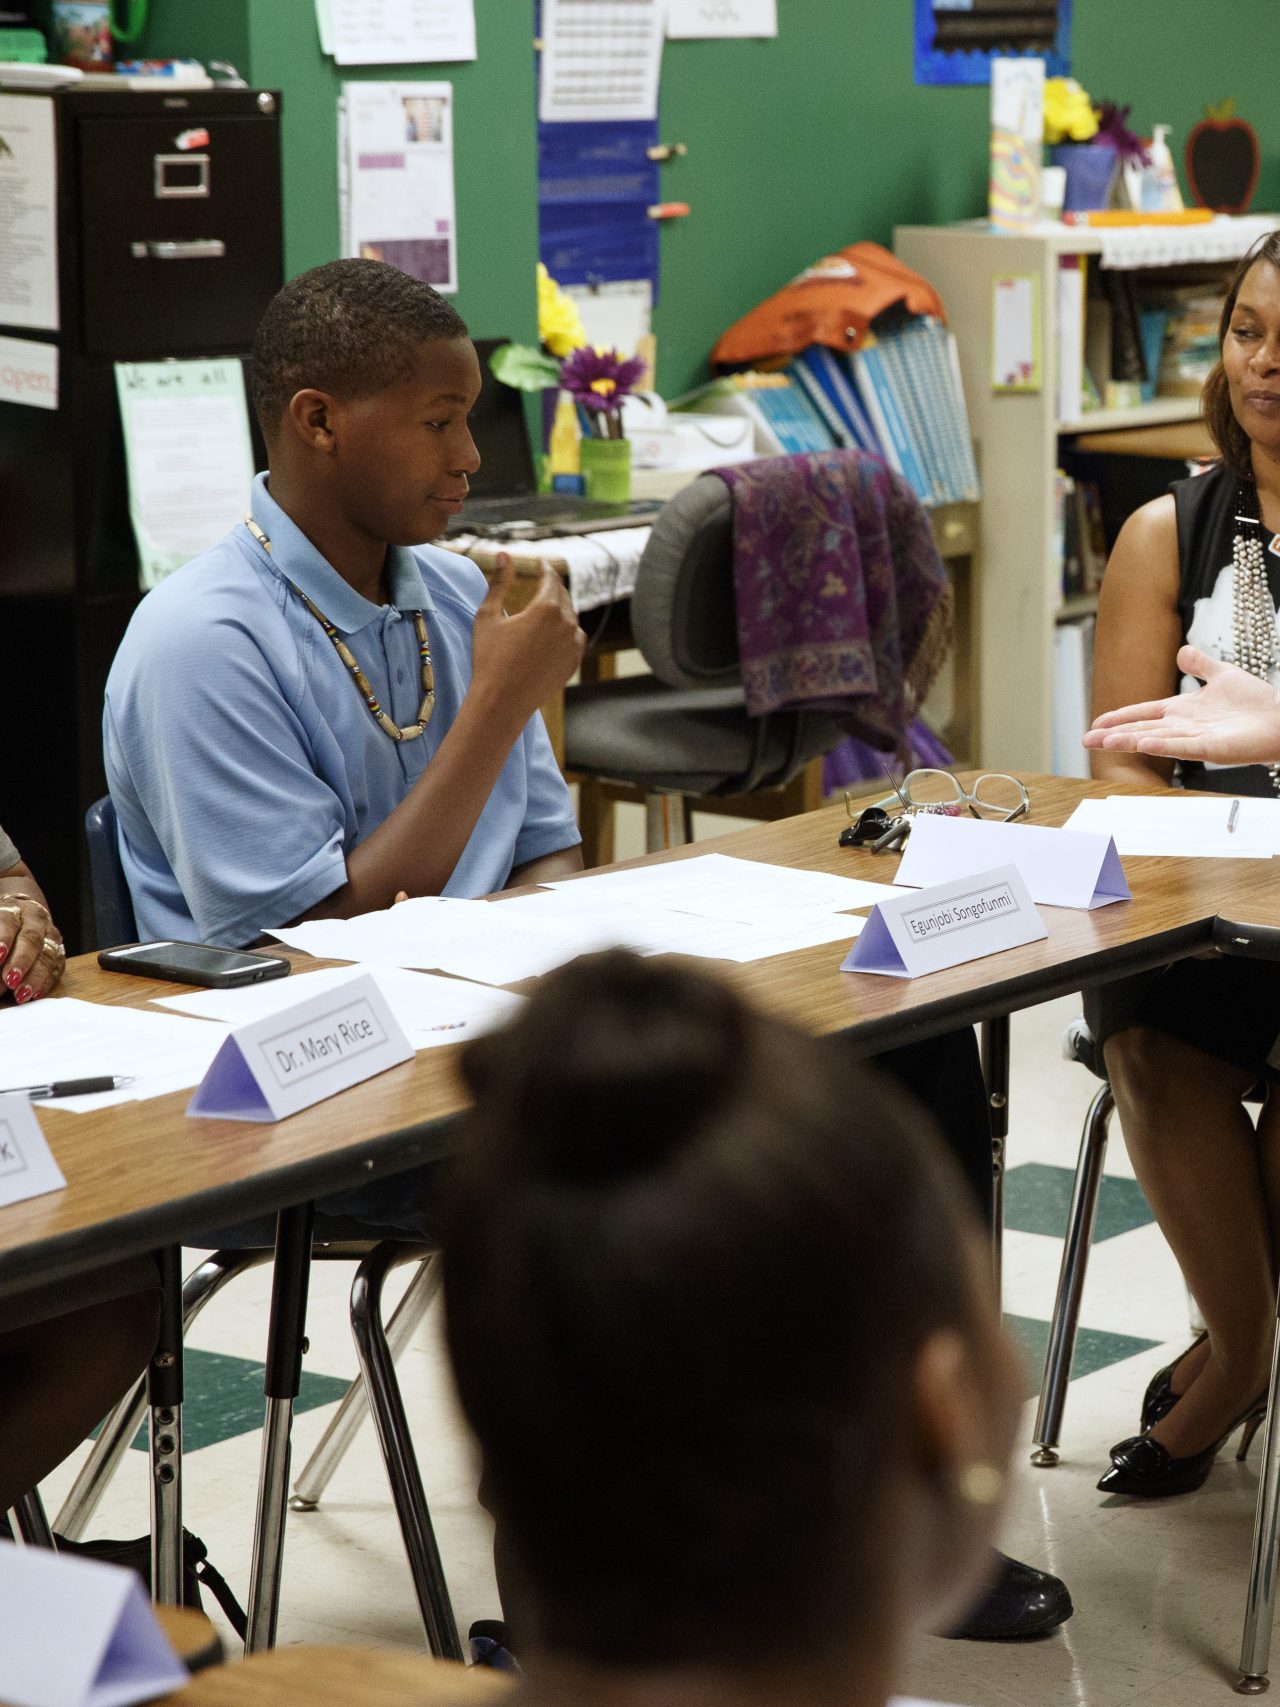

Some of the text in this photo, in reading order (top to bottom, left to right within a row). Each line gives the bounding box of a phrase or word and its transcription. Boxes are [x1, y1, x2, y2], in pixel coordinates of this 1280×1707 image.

[910, 891, 1013, 936] Egunjobi Songofunmi
[275, 1016, 374, 1074] Dr. Mary Rice
